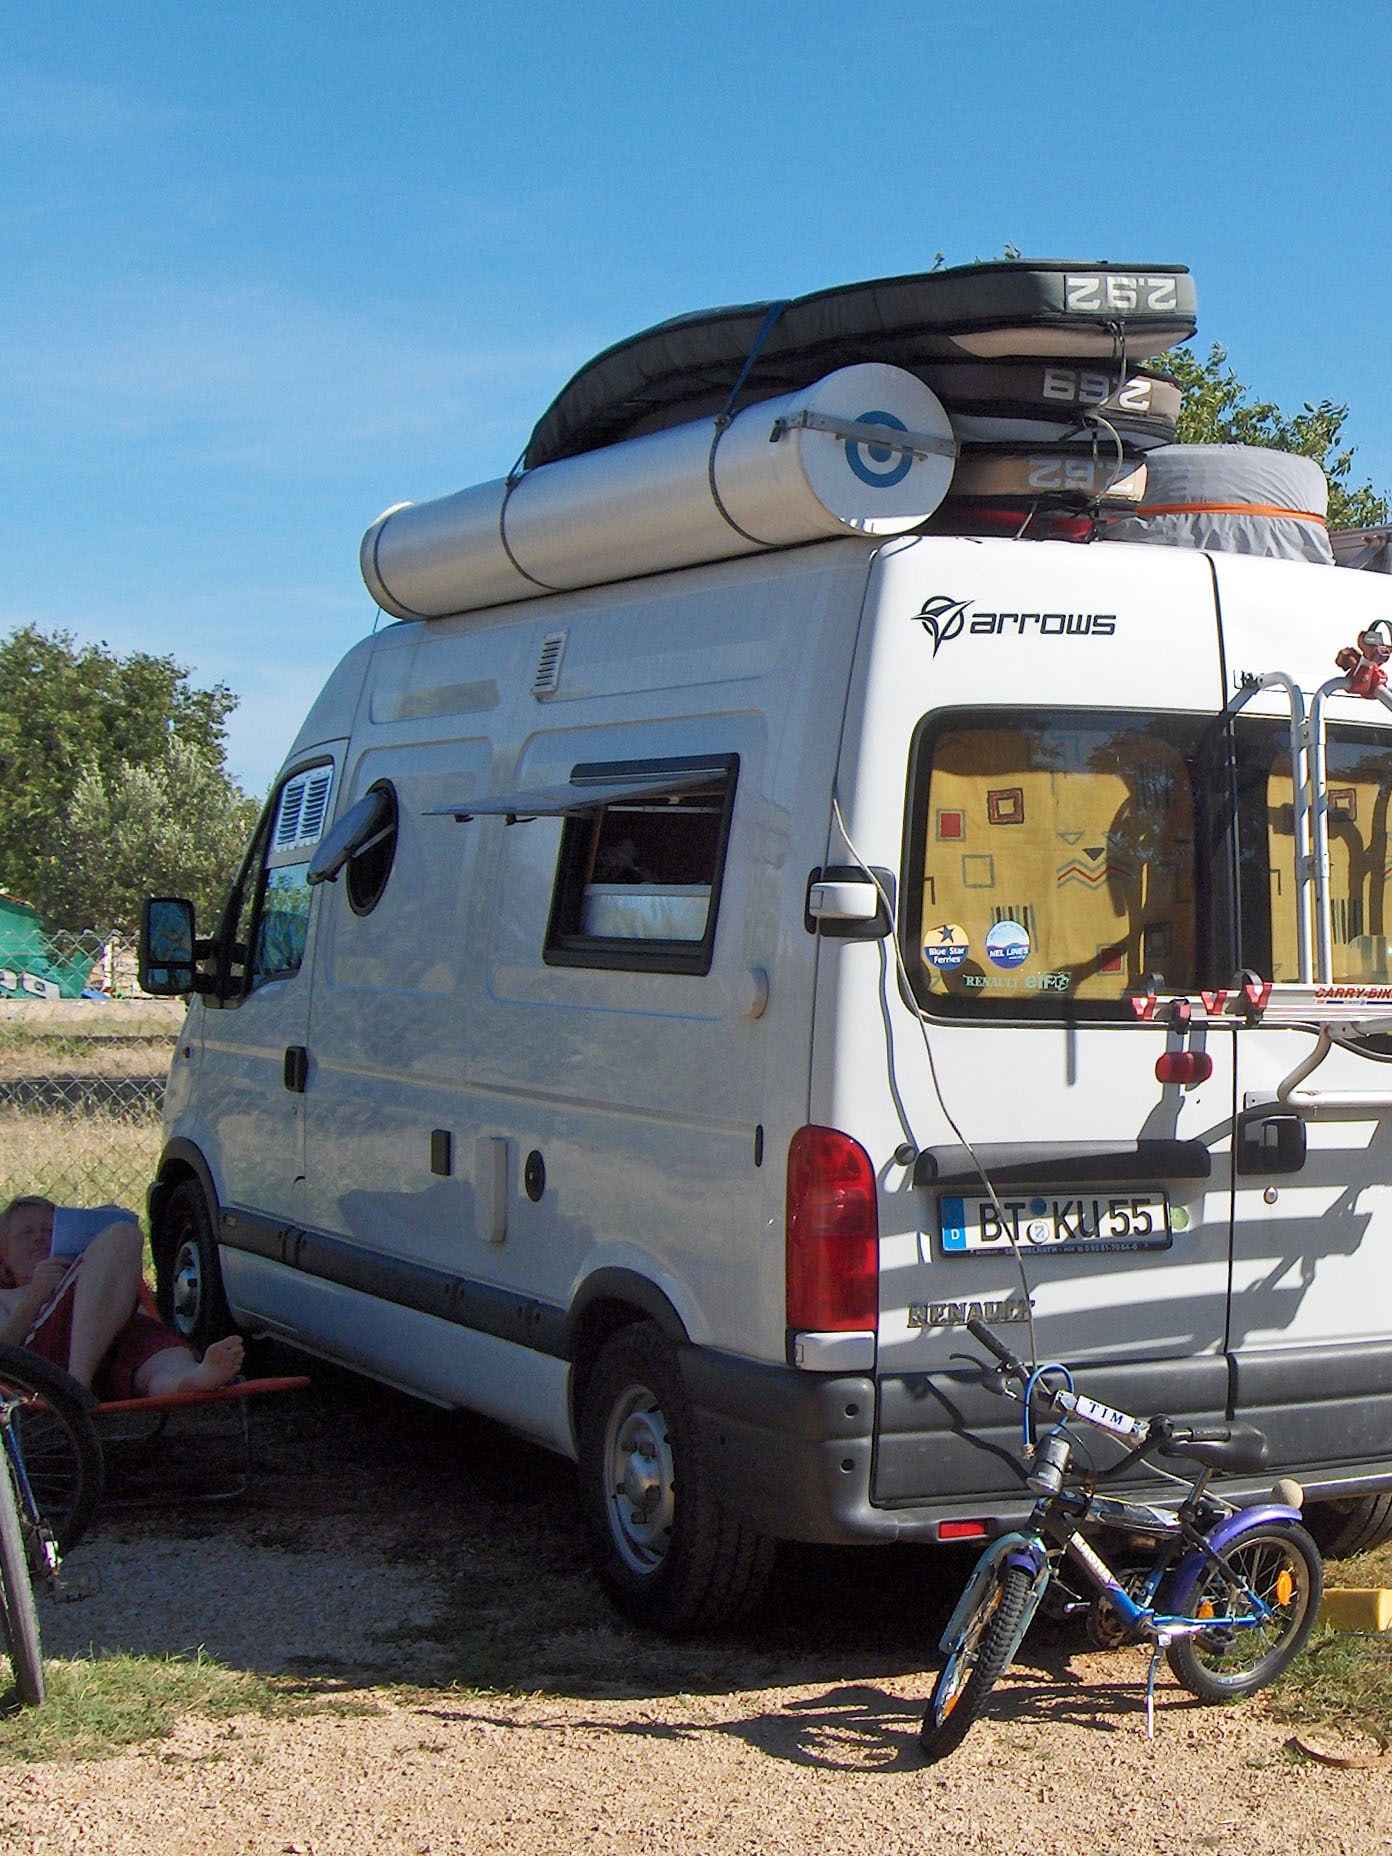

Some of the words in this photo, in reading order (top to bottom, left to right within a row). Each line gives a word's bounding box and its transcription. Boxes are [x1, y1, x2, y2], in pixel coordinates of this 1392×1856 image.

[970, 612, 1117, 636] arrows
[928, 947, 947, 956] Blue
[949, 946, 965, 955] Star
[933, 955, 961, 964] Ferries
[978, 1201, 1026, 1242] BT
[1053, 1199, 1101, 1240] KU
[1108, 1198, 1153, 1236] 55
[951, 1228, 961, 1240] D
[907, 1297, 1035, 1329] RENAULT
[1088, 1401, 1124, 1426] TIM
